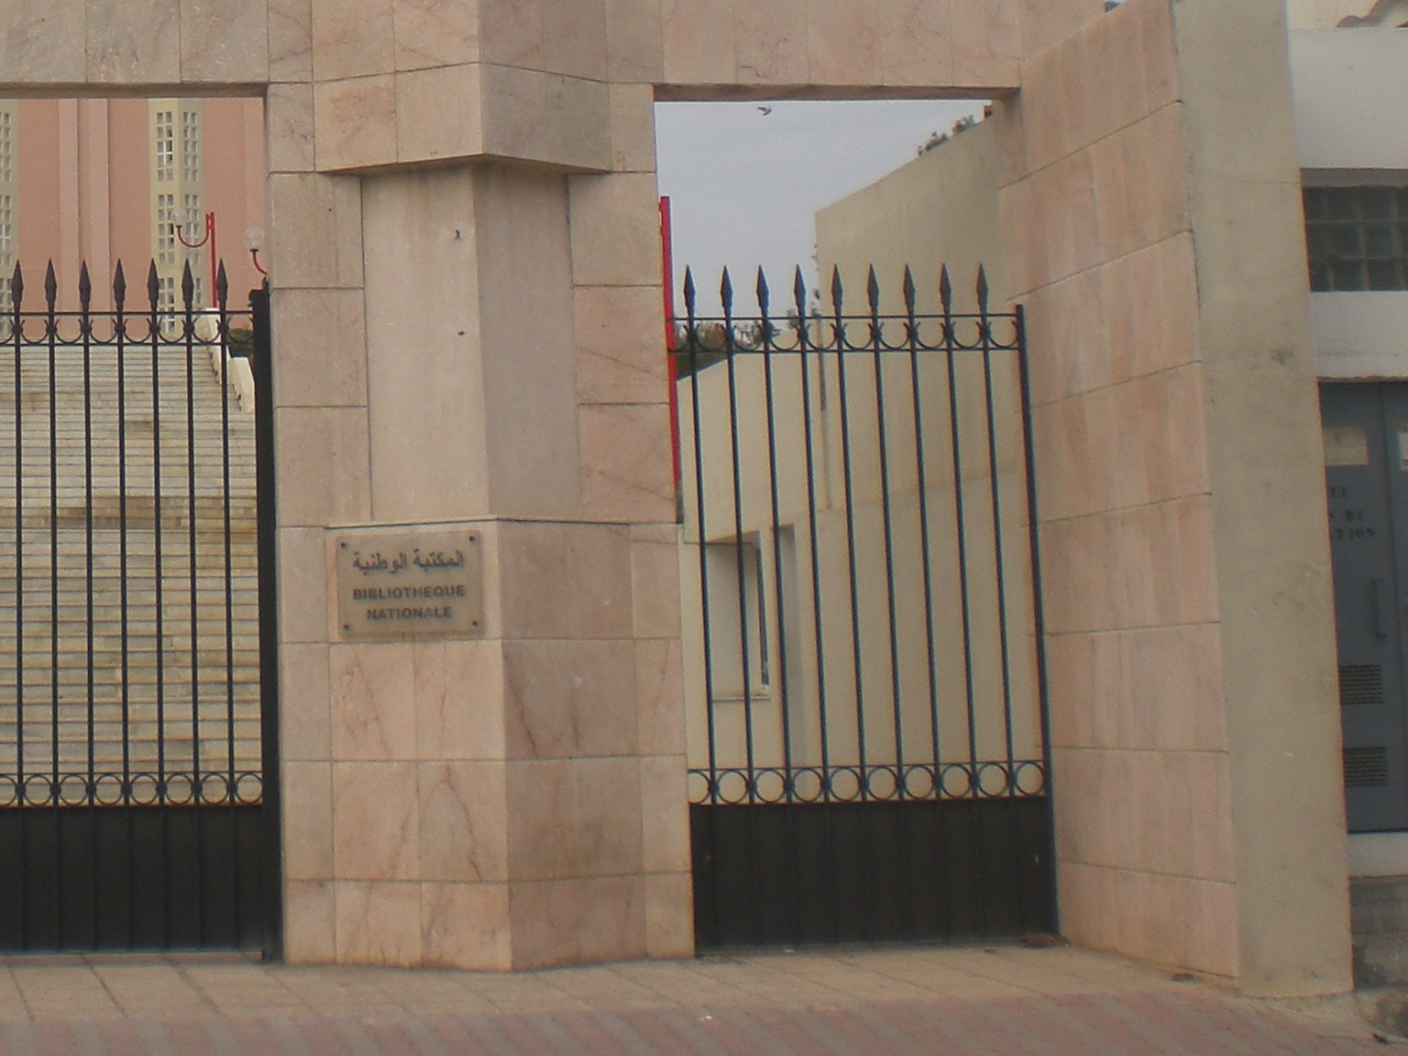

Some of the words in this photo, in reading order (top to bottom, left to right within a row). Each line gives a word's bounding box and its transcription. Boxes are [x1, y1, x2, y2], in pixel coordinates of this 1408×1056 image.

[353, 551, 408, 576] الوطنية
[413, 548, 465, 573] المكتبة
[353, 585, 466, 600] BIBLIOTHEQUE
[367, 606, 453, 620] NATIONALE
